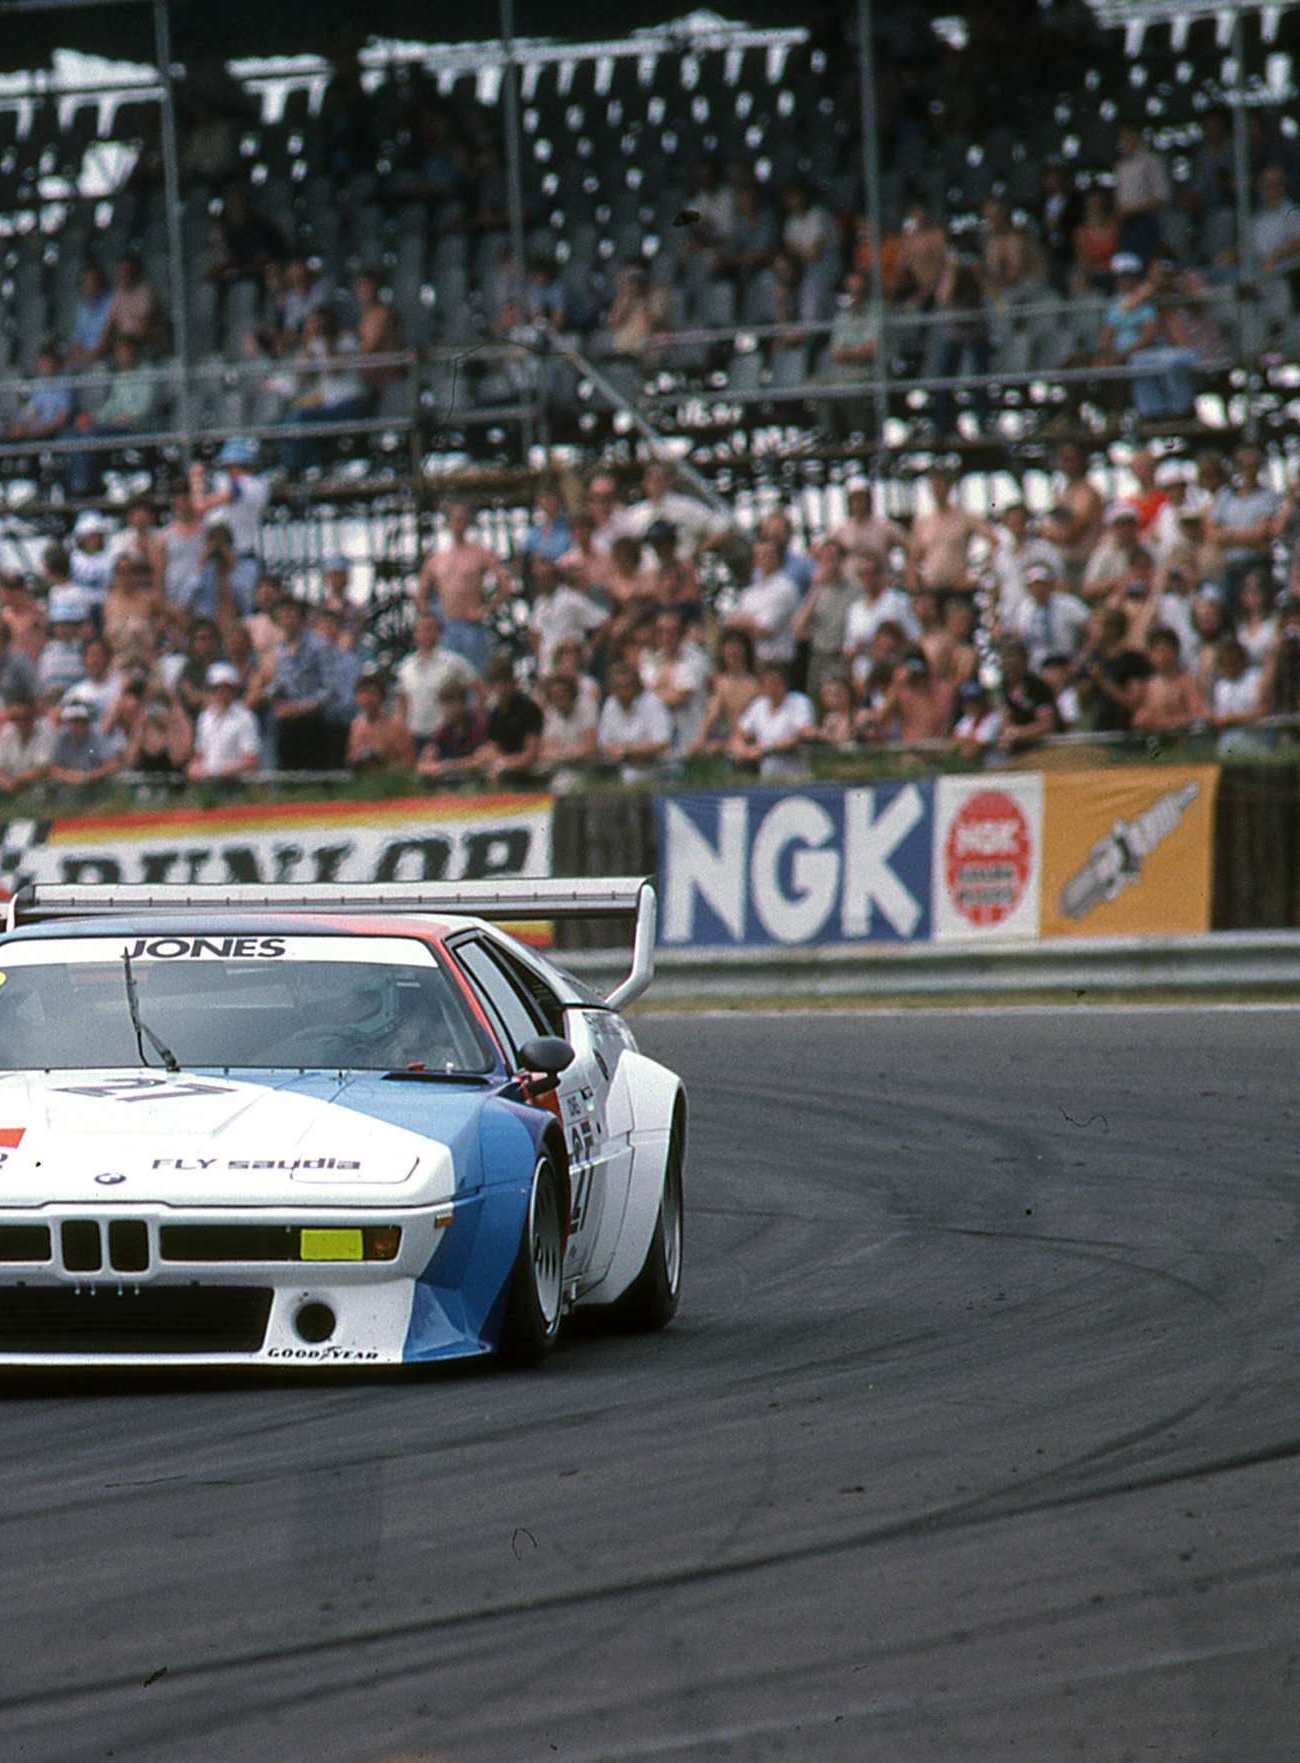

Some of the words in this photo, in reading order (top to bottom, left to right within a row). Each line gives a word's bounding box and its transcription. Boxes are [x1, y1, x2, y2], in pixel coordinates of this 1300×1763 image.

[663, 784, 926, 943] NGK
[127, 938, 286, 959] JONES
[152, 1158, 217, 1170] FLY
[228, 1158, 361, 1170] saudia
